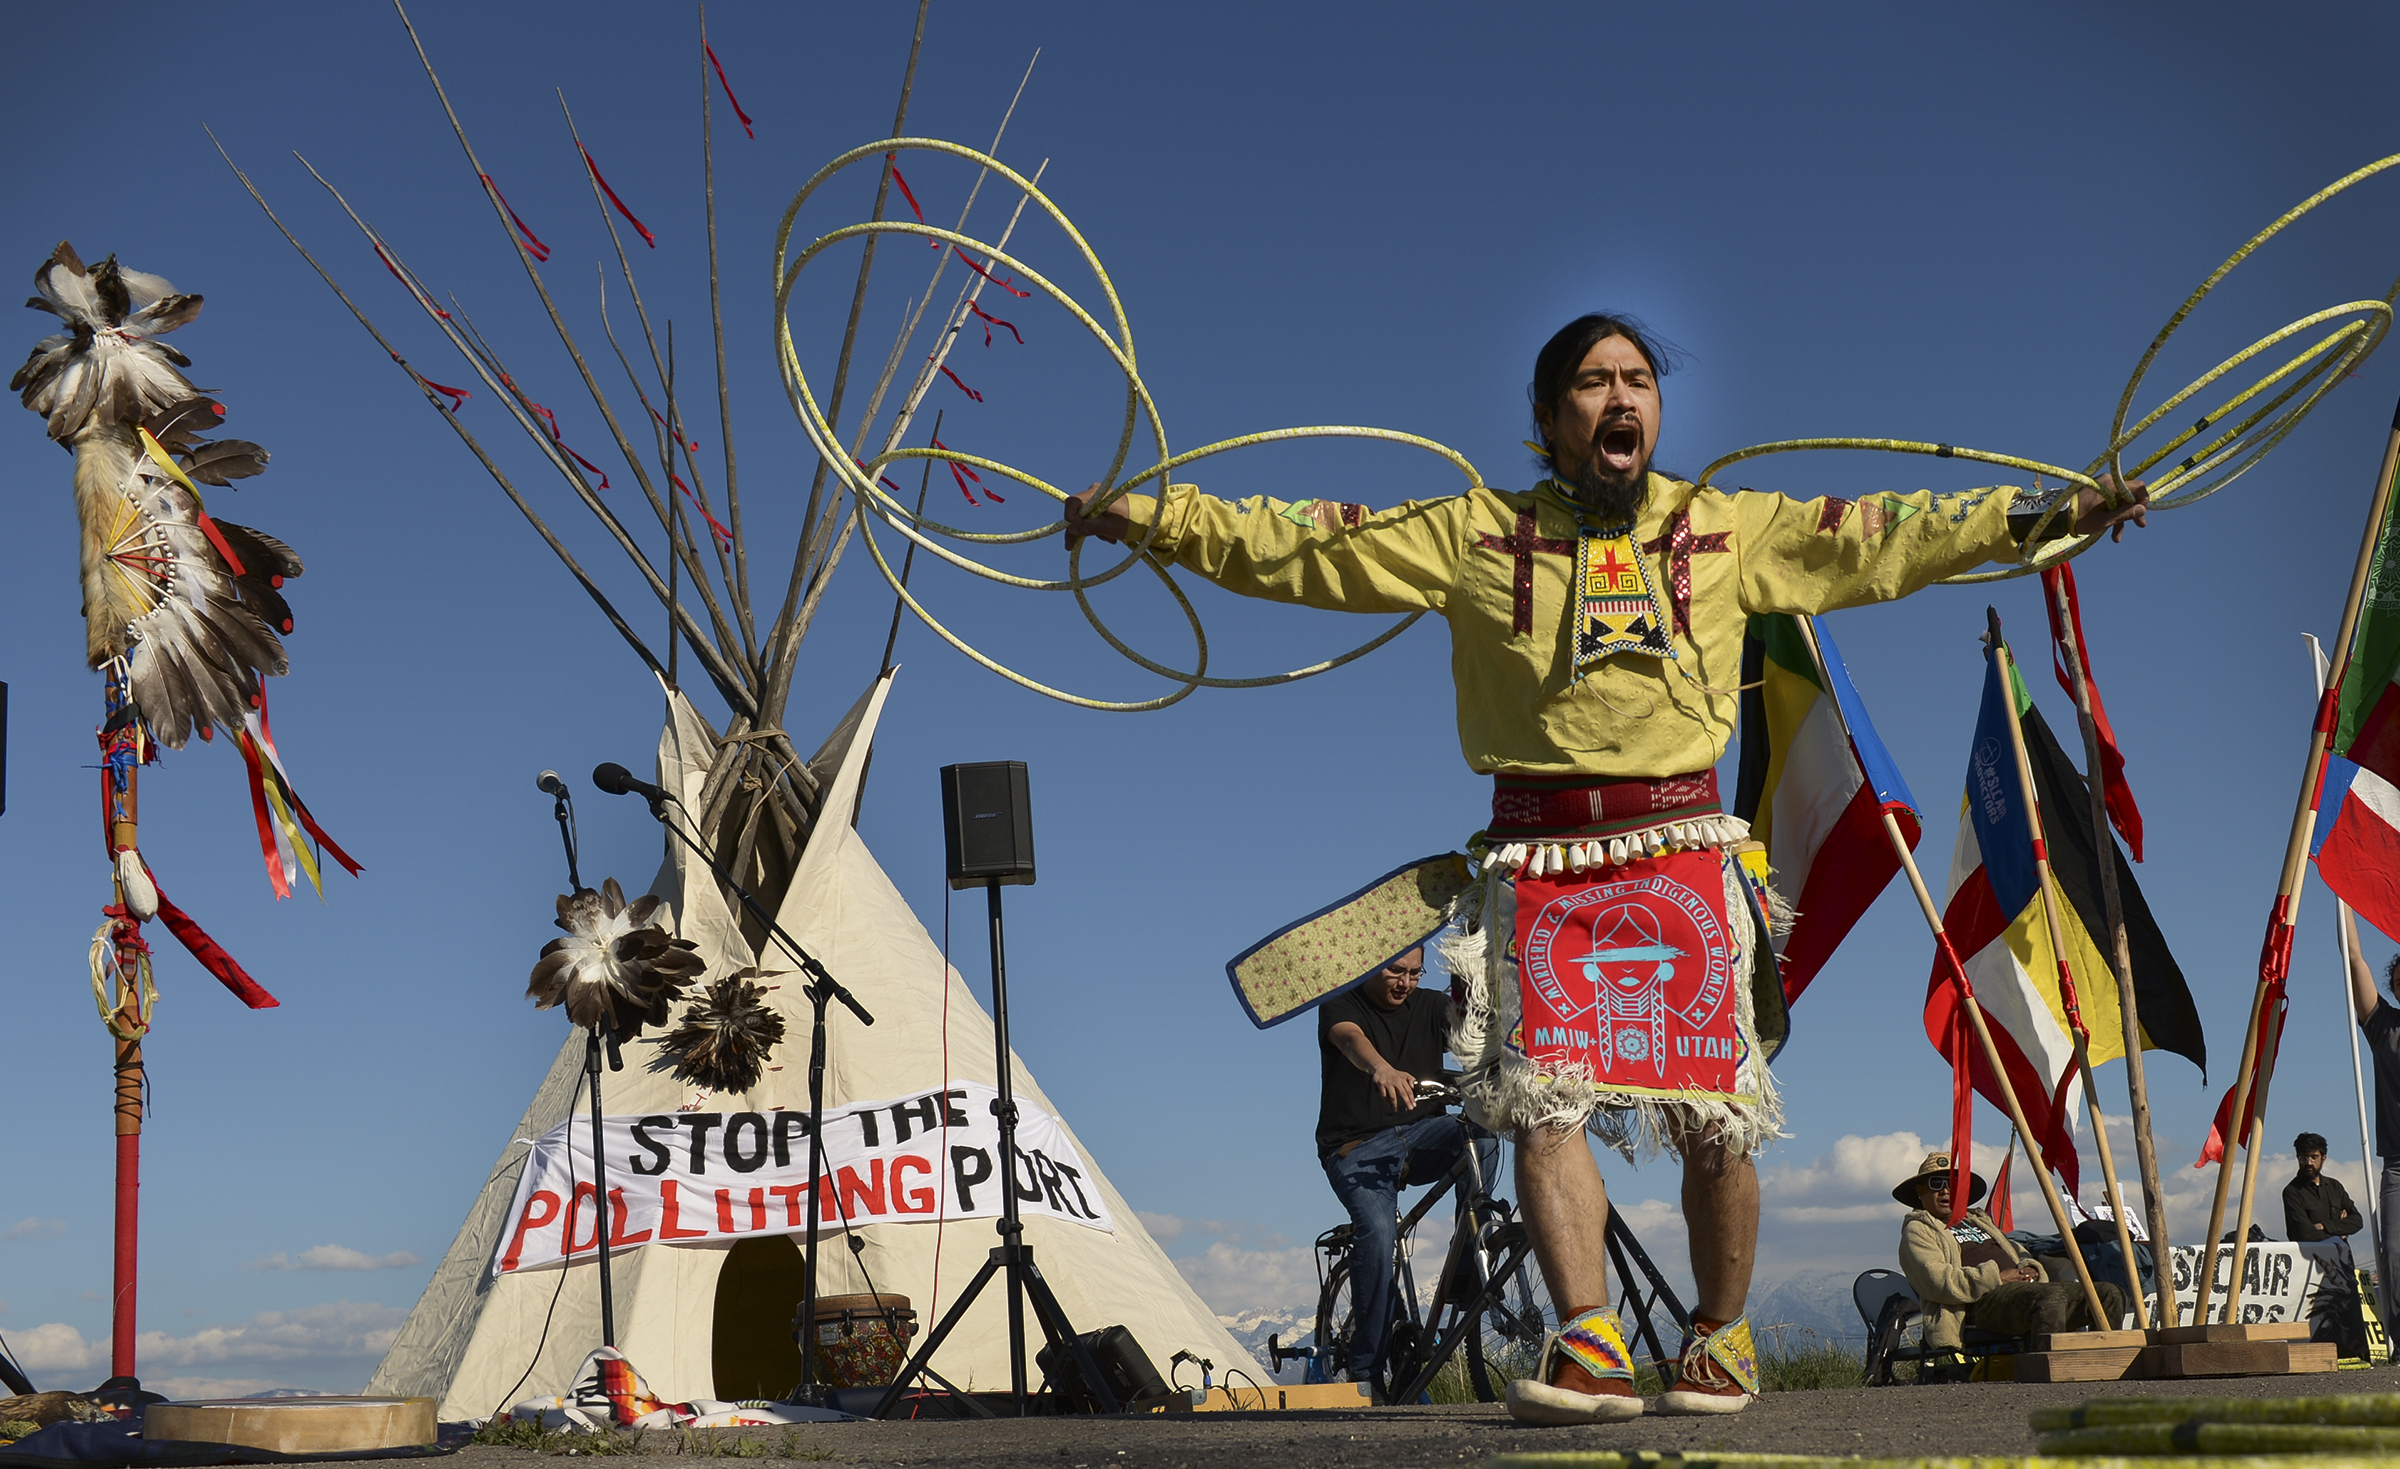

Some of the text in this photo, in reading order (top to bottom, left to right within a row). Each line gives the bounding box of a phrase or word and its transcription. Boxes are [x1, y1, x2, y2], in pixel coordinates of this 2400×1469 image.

[1530, 928, 1562, 1000] MURDERED
[1558, 885, 1625, 910] MISSING
[1633, 877, 1719, 939] INDIGENOUS
[1700, 946, 1726, 1006] WOMEN
[1676, 1035, 1733, 1060] UTAH
[629, 1089, 970, 1176] STOP THE
[501, 1144, 1101, 1272] POLLUTING PORT
